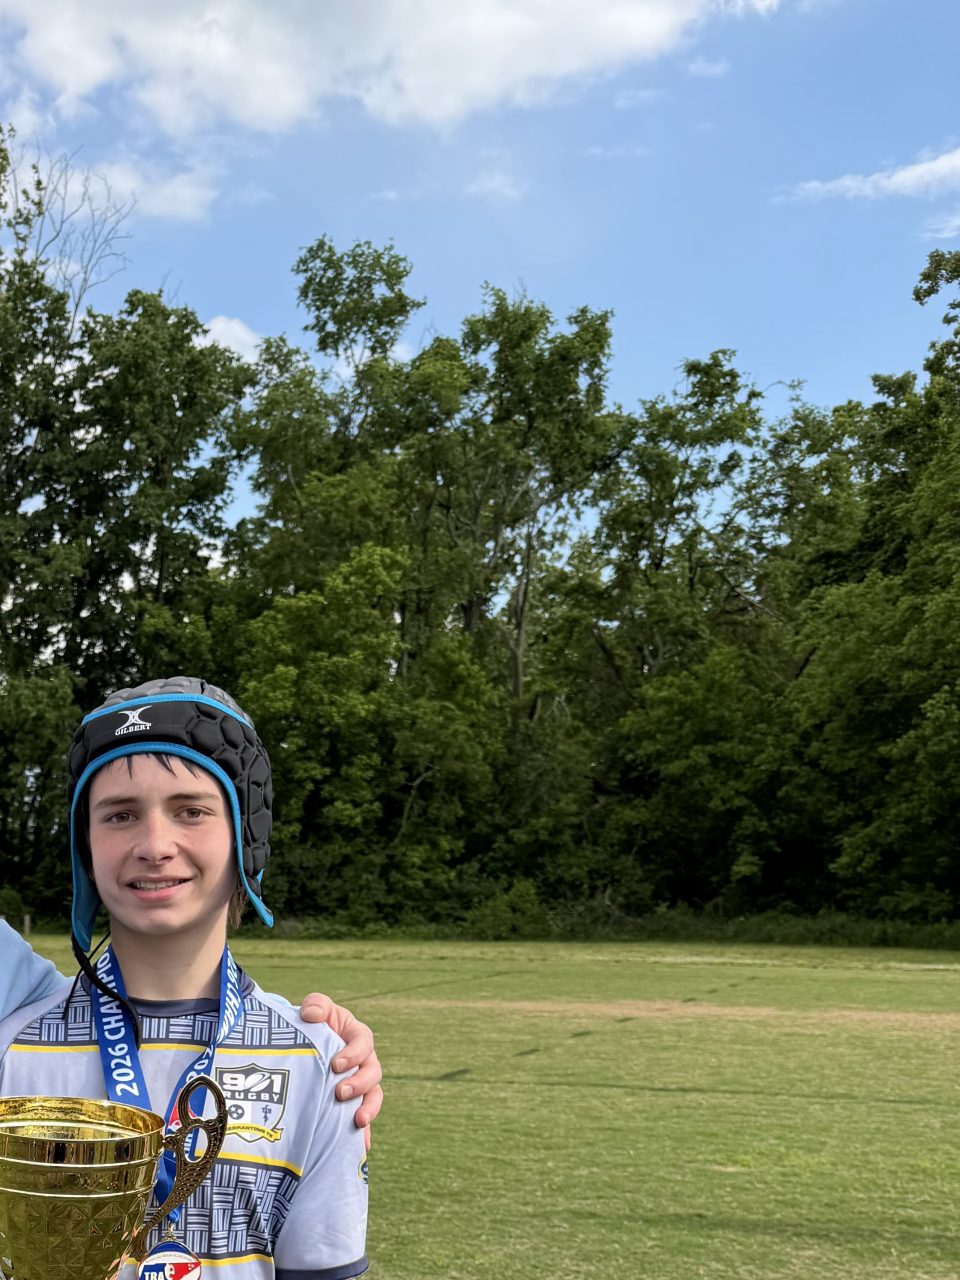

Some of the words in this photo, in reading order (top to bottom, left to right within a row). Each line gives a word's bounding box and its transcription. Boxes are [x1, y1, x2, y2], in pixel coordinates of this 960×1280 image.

[115, 723, 151, 735] GILBERT
[96, 946, 126, 1041] CHAMPIO
[108, 1043, 139, 1097] 2026
[222, 1071, 282, 1093] 901
[223, 1091, 279, 1102] RUGBY
